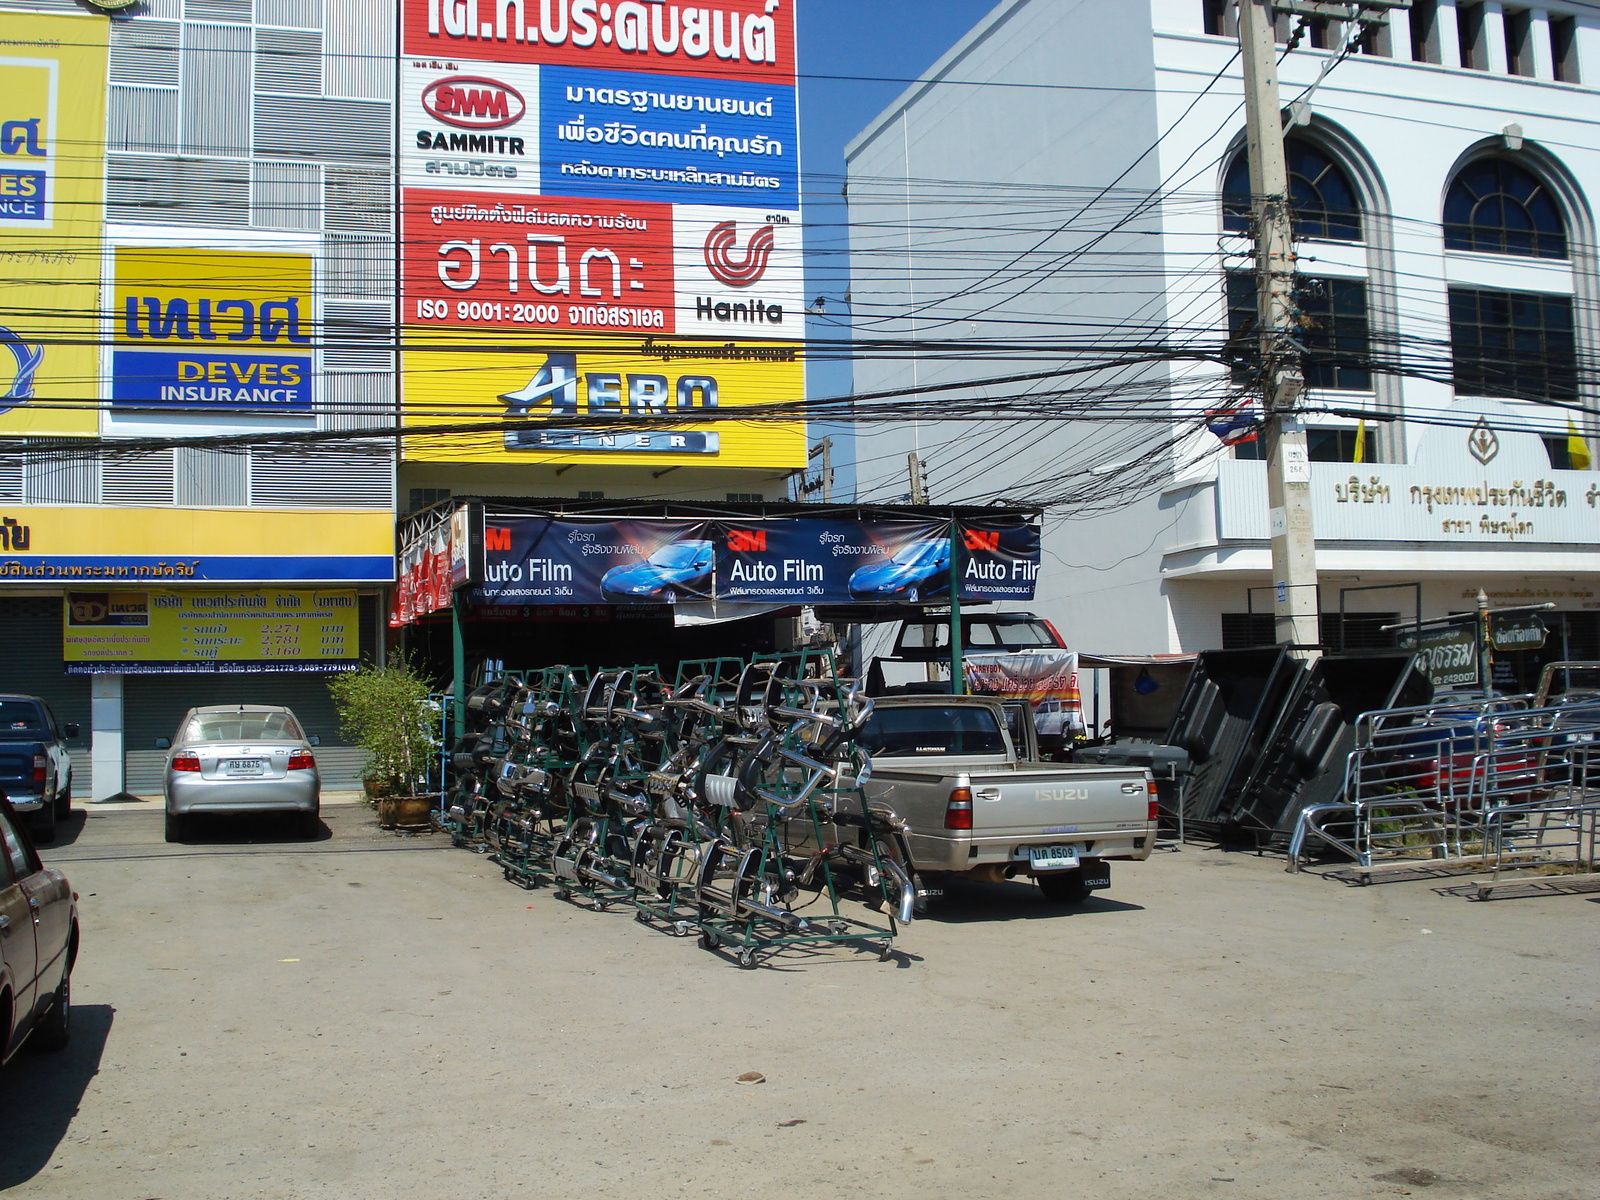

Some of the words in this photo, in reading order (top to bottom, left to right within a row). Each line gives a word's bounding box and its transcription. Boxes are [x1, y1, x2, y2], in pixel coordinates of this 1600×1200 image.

[434, 85, 510, 119] SMM
[566, 85, 774, 117] มาตรฐานยานยนต์
[416, 130, 526, 156] SAMMITR
[557, 114, 784, 158] เพื่อชีวิตคนที่คุณรัก
[561, 160, 782, 189] หลังคากระบะเหล็กสามมิตร
[430, 202, 648, 231] ศูนย์ติดตั้งฟิล์มลดความร้อน
[126, 296, 311, 343] เทเวศ
[417, 299, 448, 319] ISO
[457, 301, 560, 324] 9001:2000
[568, 302, 665, 328] จากอิสราเอล
[696, 296, 783, 324] Hanita
[177, 360, 301, 386] DEVES
[160, 385, 298, 404] INSURANCE
[540, 433, 687, 448] LINER
[1335, 475, 1391, 504] บริษัท
[1410, 479, 1567, 514] กรุงเทพประกันชีวิต
[1441, 518, 1472, 534] สาขา
[1480, 512, 1534, 541] พิษณุโลก
[727, 530, 767, 552] 3M
[964, 529, 999, 552] 3M
[529, 558, 573, 582] Film
[730, 559, 777, 582] Auto
[783, 559, 824, 582] Film
[965, 557, 1007, 580] Auto
[1035, 788, 1089, 801] ISUZU
[1051, 847, 1074, 859] 8509
[917, 889, 944, 897] ISUZU
